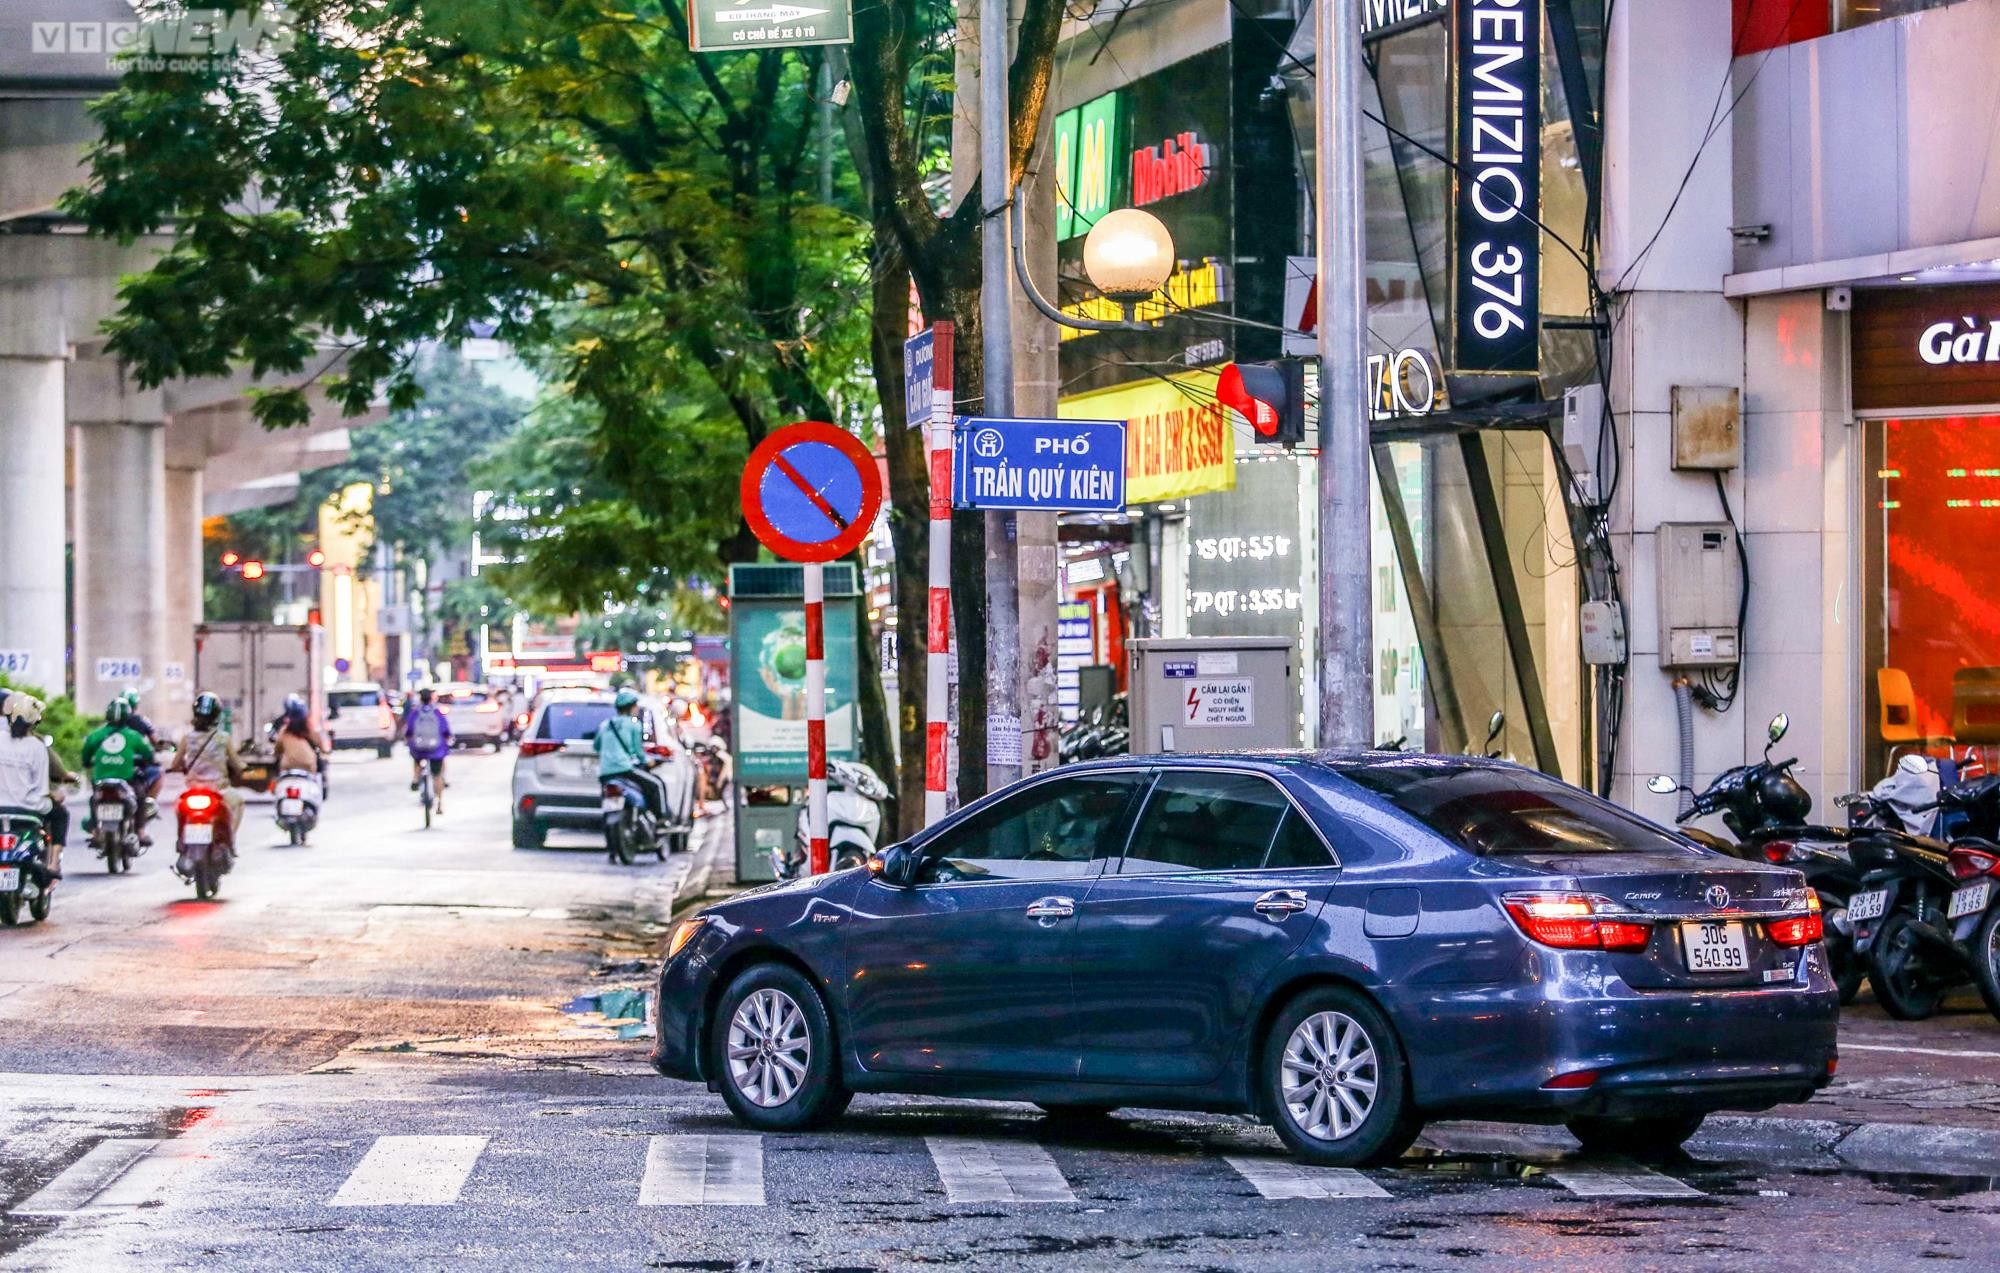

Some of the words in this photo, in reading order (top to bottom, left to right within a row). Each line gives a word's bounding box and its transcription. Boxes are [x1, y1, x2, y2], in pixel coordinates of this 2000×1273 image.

[1472, 0, 1524, 222] EMIZIO
[1133, 131, 1204, 207] Mobile
[1471, 242, 1525, 339] 376
[1035, 431, 1092, 455] PHỐ
[973, 457, 1022, 498] TRẦN
[1028, 462, 1064, 502] QUÝ
[1070, 464, 1114, 501] KIÊN
[1624, 892, 1662, 901] Camry
[1700, 926, 1728, 945] 30G
[1694, 948, 1742, 968] 540.99
